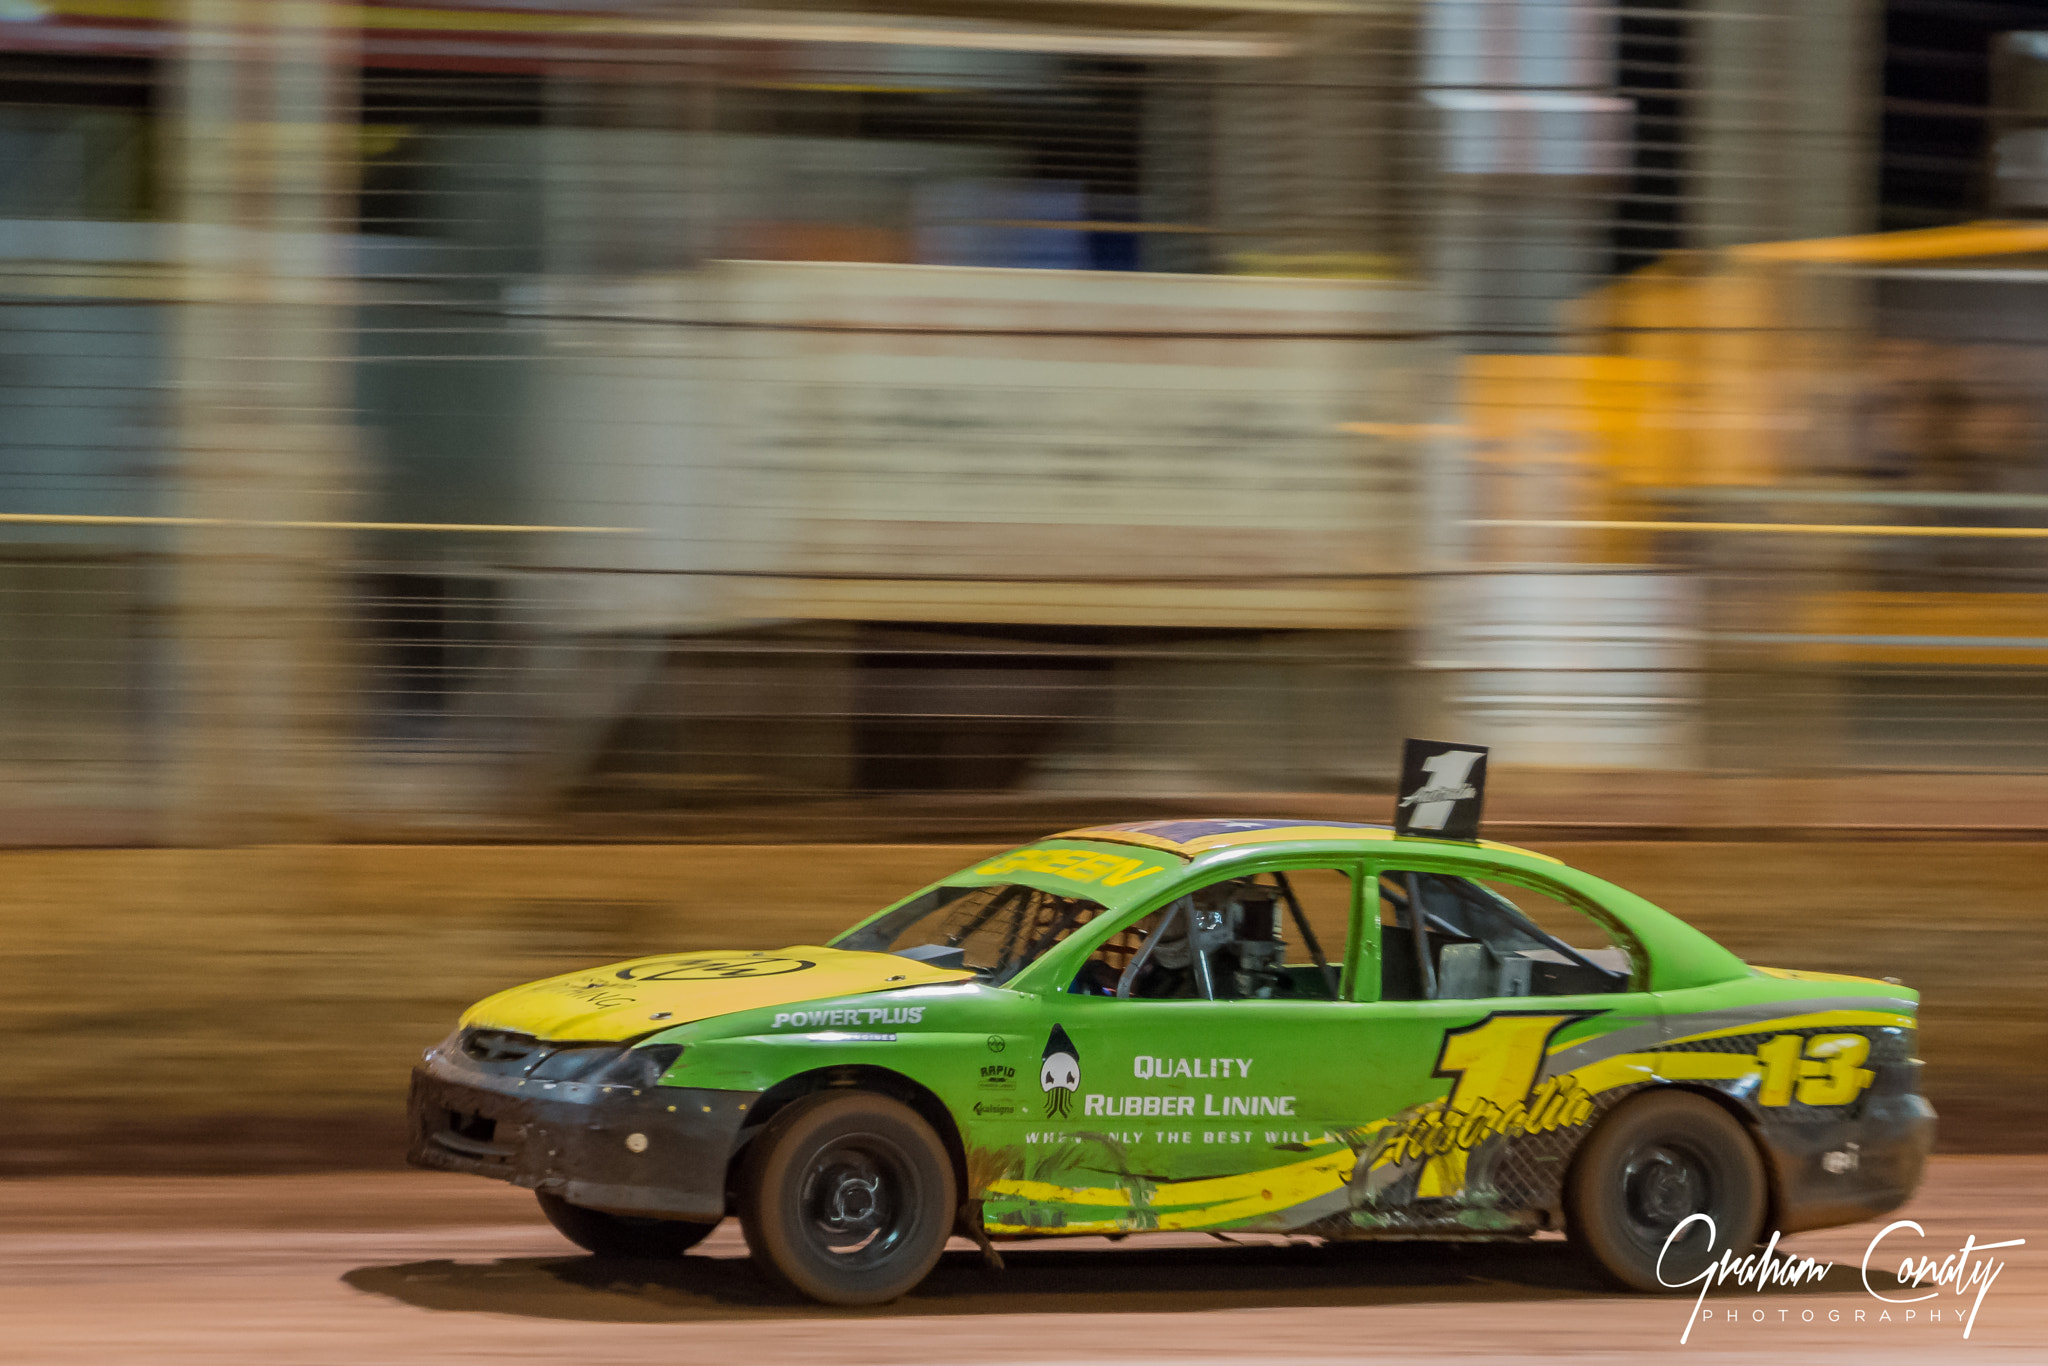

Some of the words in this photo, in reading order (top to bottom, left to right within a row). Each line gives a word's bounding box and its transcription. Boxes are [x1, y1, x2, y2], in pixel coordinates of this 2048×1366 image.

[1408, 750, 1487, 830] 1
[771, 1009, 861, 1028] POWER
[860, 1007, 926, 1025] PLUS
[980, 1065, 1016, 1078] RAPID
[1134, 1055, 1253, 1080] QUALITY
[1757, 1032, 1876, 1107] 13
[1084, 1094, 1195, 1116] RUBBER
[1107, 1131, 1143, 1144] NLY
[1155, 1131, 1191, 1144] THE
[1203, 1131, 1253, 1144] BEST
[1265, 1131, 1311, 1144] WILL
